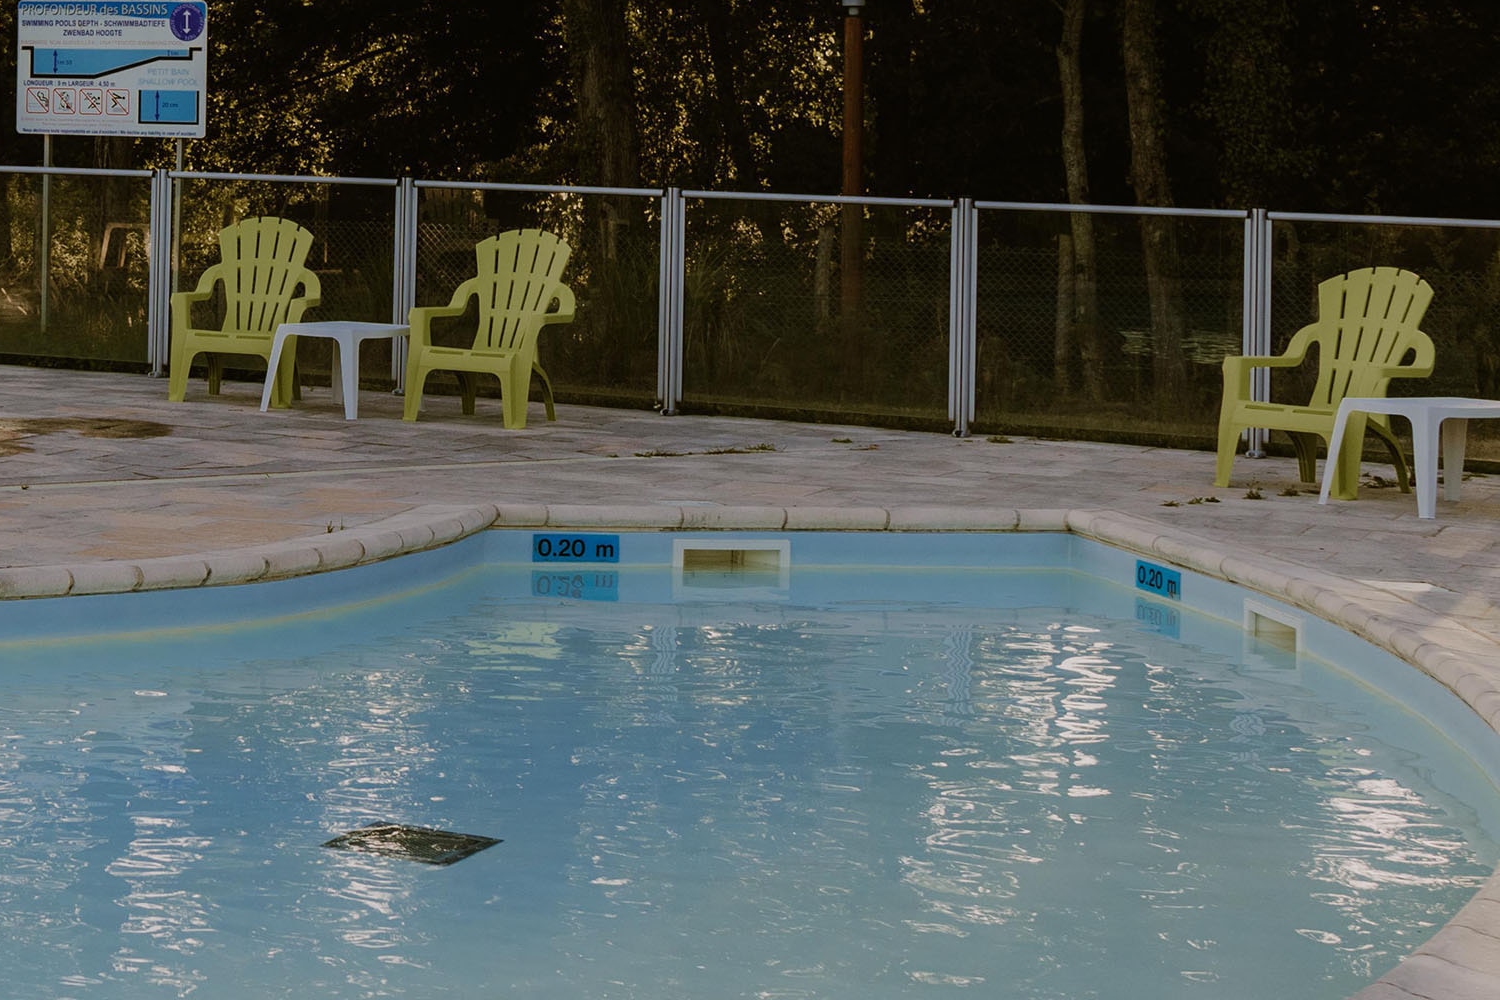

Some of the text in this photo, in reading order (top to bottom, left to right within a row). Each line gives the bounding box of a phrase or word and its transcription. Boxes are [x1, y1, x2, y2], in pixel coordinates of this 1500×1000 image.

[21, 3, 168, 16] PROFONDEUR des BASSINS
[104, 20, 166, 28] SCHWIMMBADTIEFE
[95, 29, 122, 37] HOOGTE
[537, 538, 615, 558] 0.20 m
[1137, 565, 1177, 594] 0.20 m
